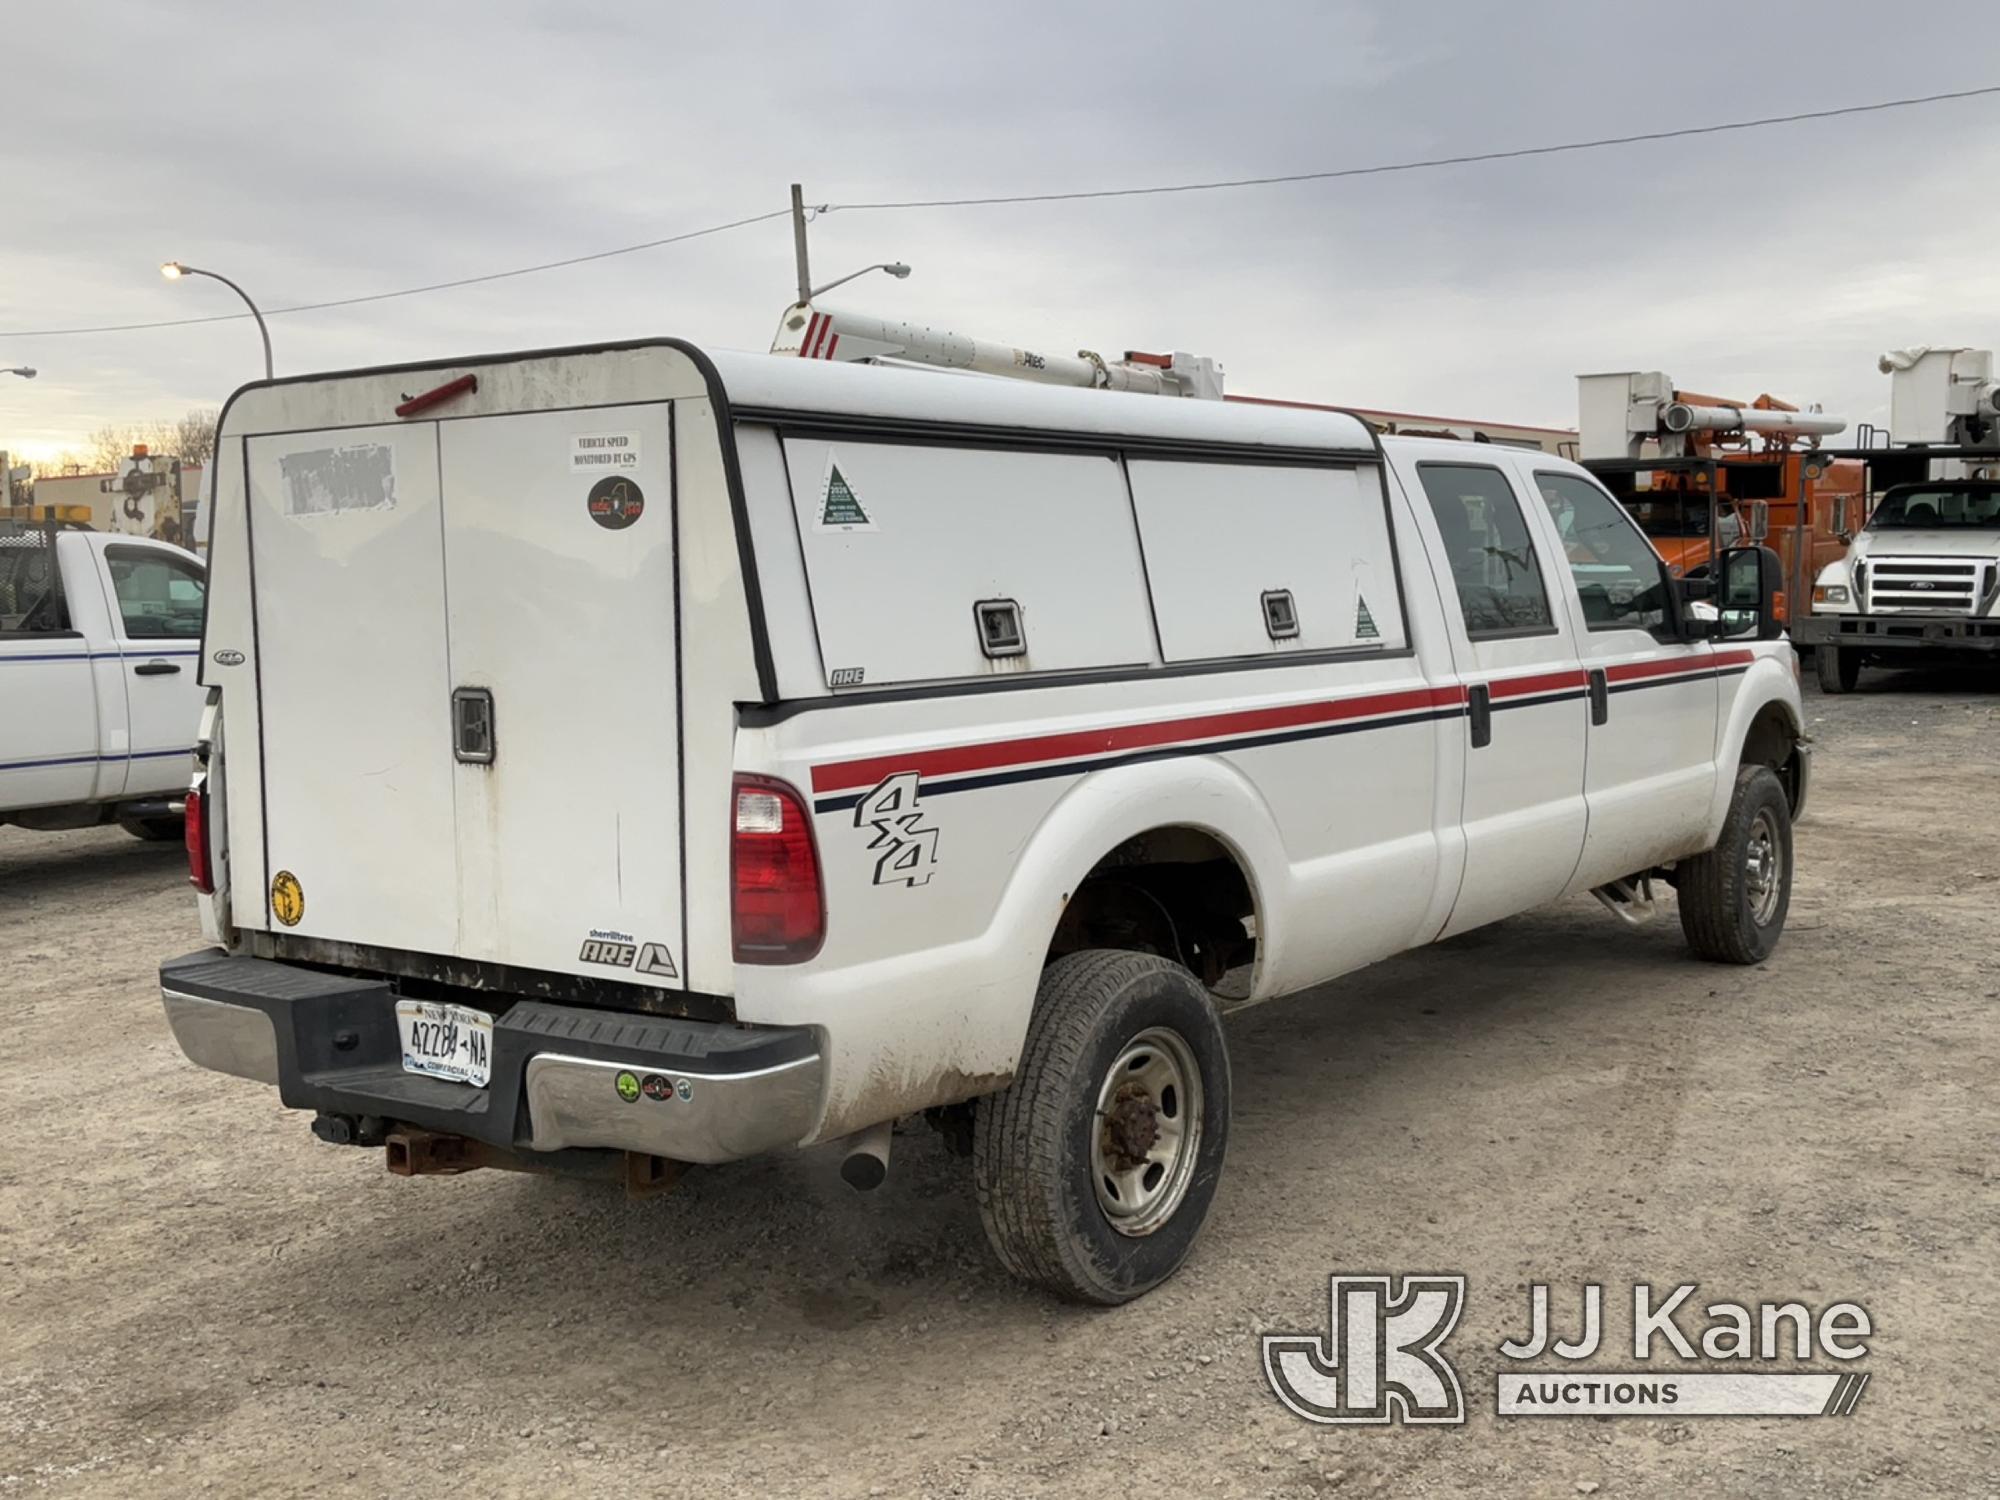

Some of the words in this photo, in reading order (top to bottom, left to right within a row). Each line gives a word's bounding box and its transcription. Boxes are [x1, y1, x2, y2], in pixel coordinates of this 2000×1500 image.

[578, 437, 606, 448] VEHICLE
[607, 436, 629, 447] SPEED
[574, 453, 612, 465] MONITORED
[613, 453, 622, 464] BY
[623, 452, 637, 463] GPS
[831, 667, 864, 686] ARE
[579, 939, 637, 967] ARE
[424, 1009, 446, 1021] NEW
